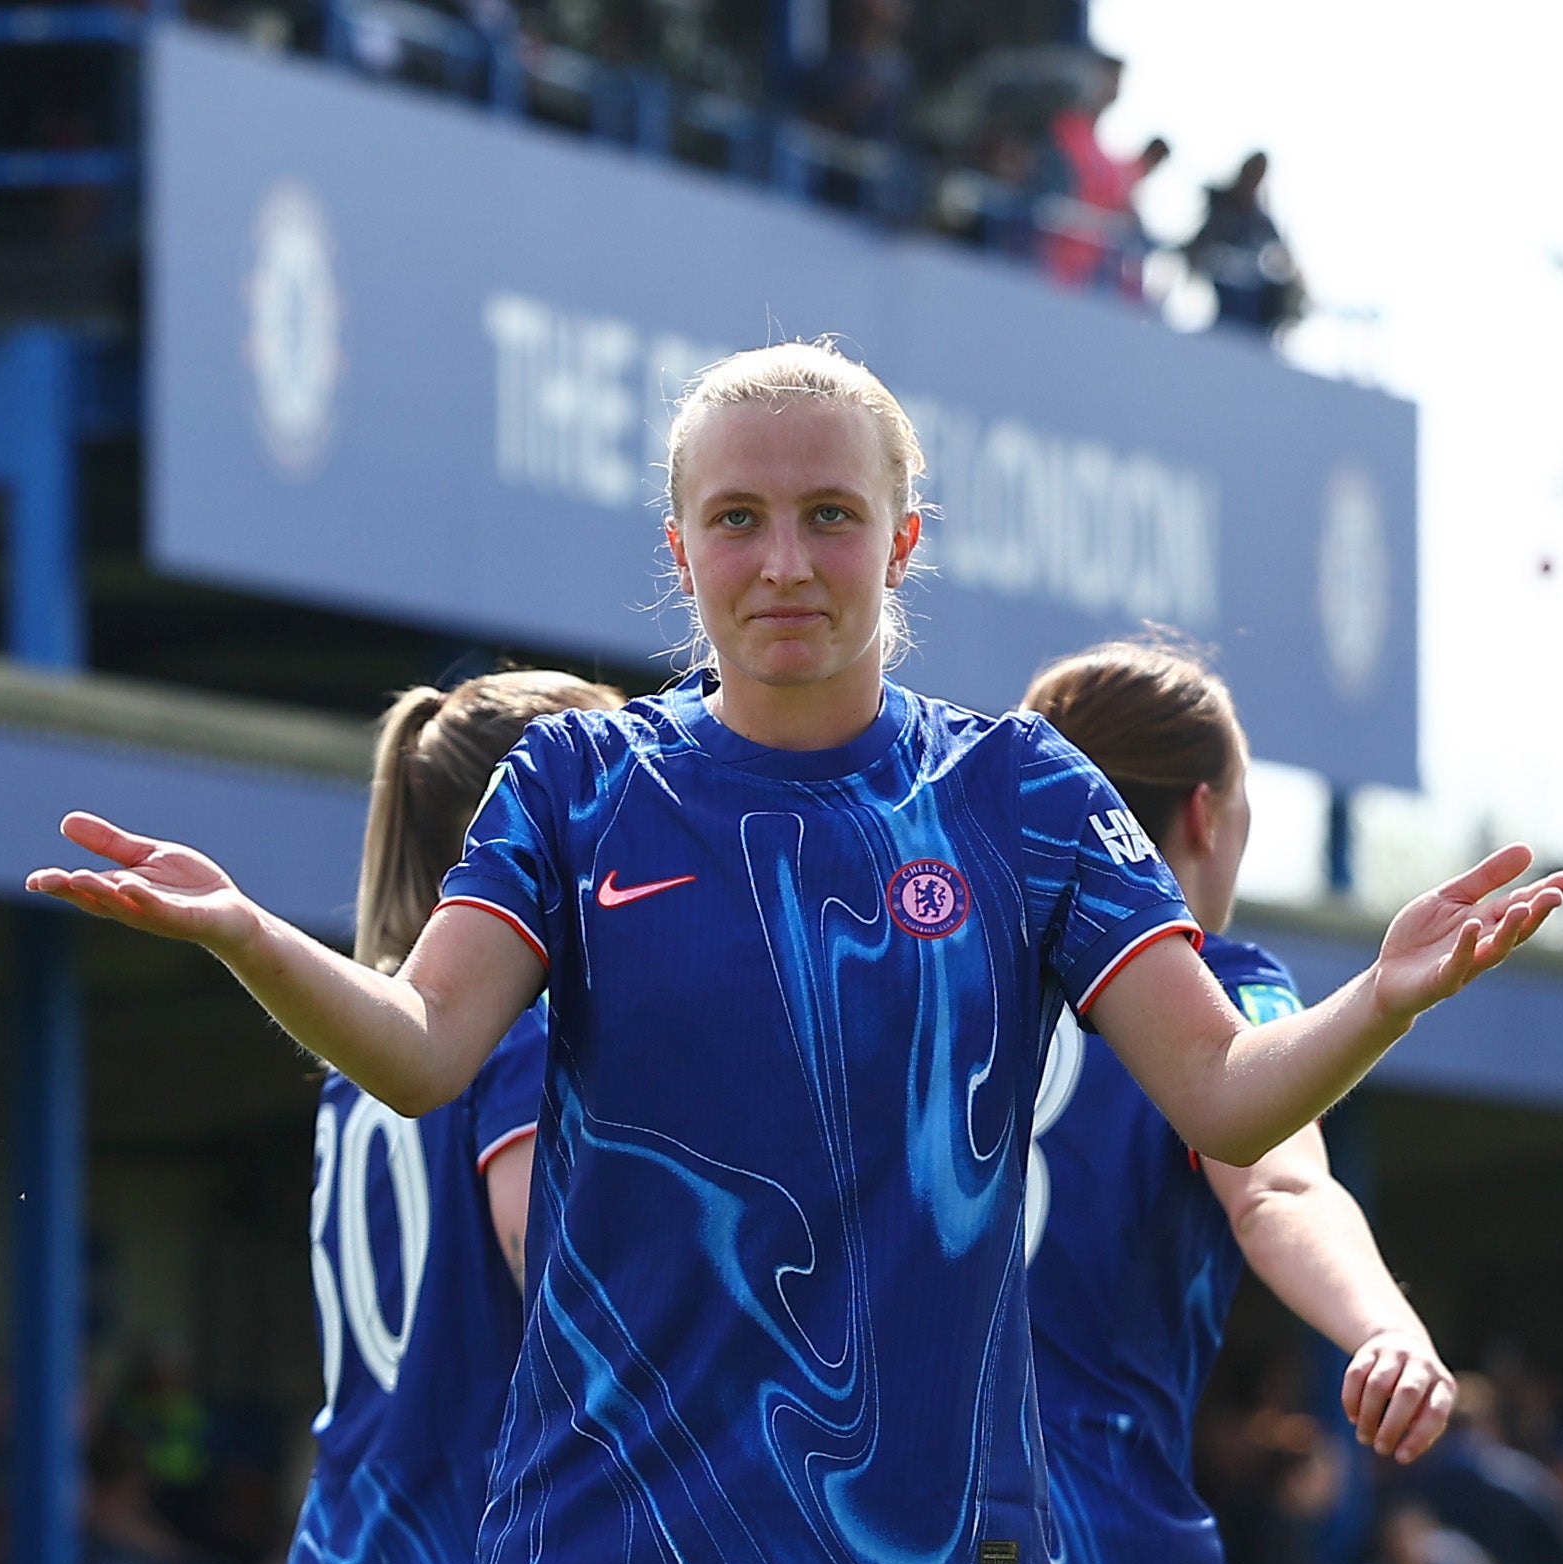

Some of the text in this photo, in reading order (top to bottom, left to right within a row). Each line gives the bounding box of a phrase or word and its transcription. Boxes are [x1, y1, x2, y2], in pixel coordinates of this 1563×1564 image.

[486, 294, 639, 506] THE
[940, 410, 1220, 622] LONDON
[902, 864, 952, 880] CHELSEA
